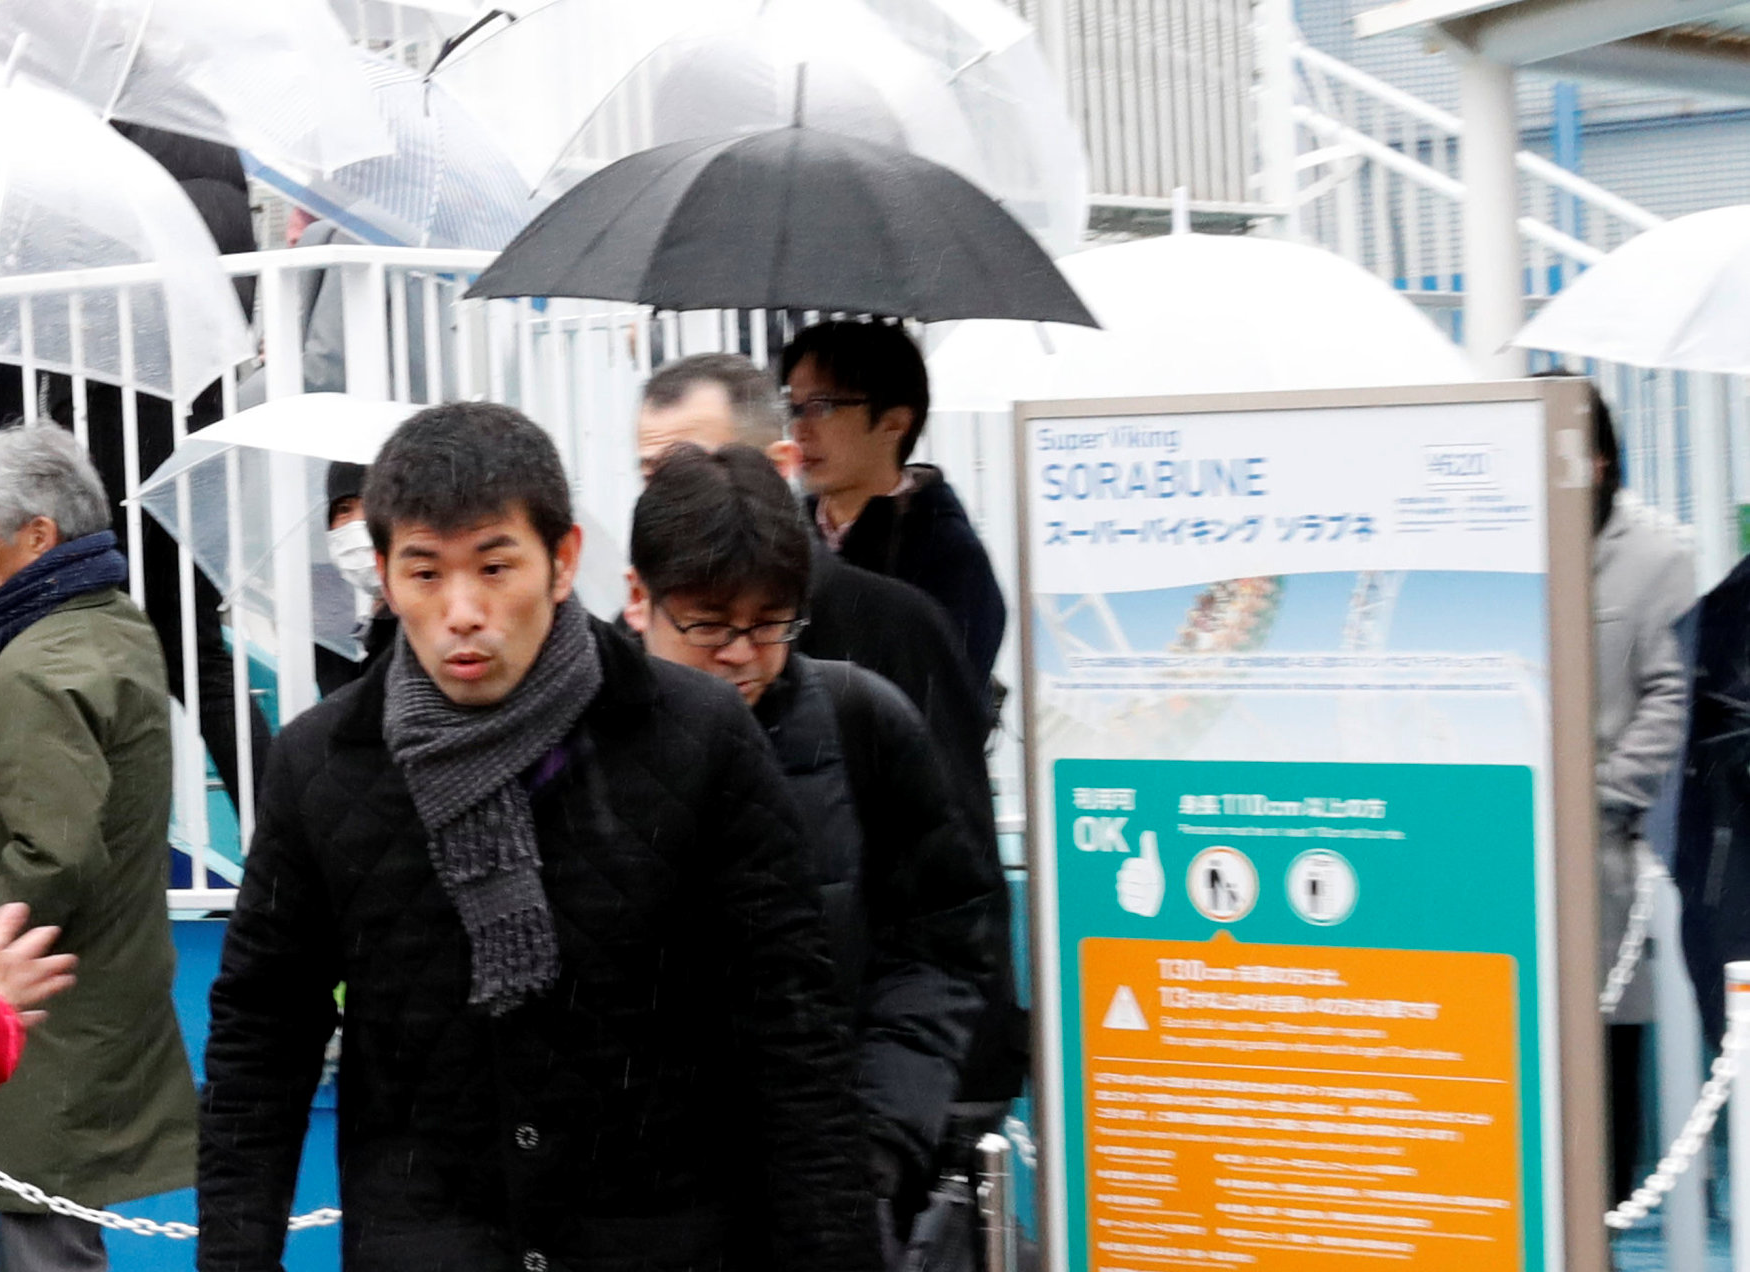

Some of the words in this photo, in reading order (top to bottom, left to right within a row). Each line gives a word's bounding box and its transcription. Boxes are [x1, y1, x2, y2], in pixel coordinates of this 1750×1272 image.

[1037, 427, 1108, 455] Super
[1109, 424, 1181, 454] Viking
[1041, 456, 1269, 501] SORABUNE
[1072, 815, 1131, 853] OK
